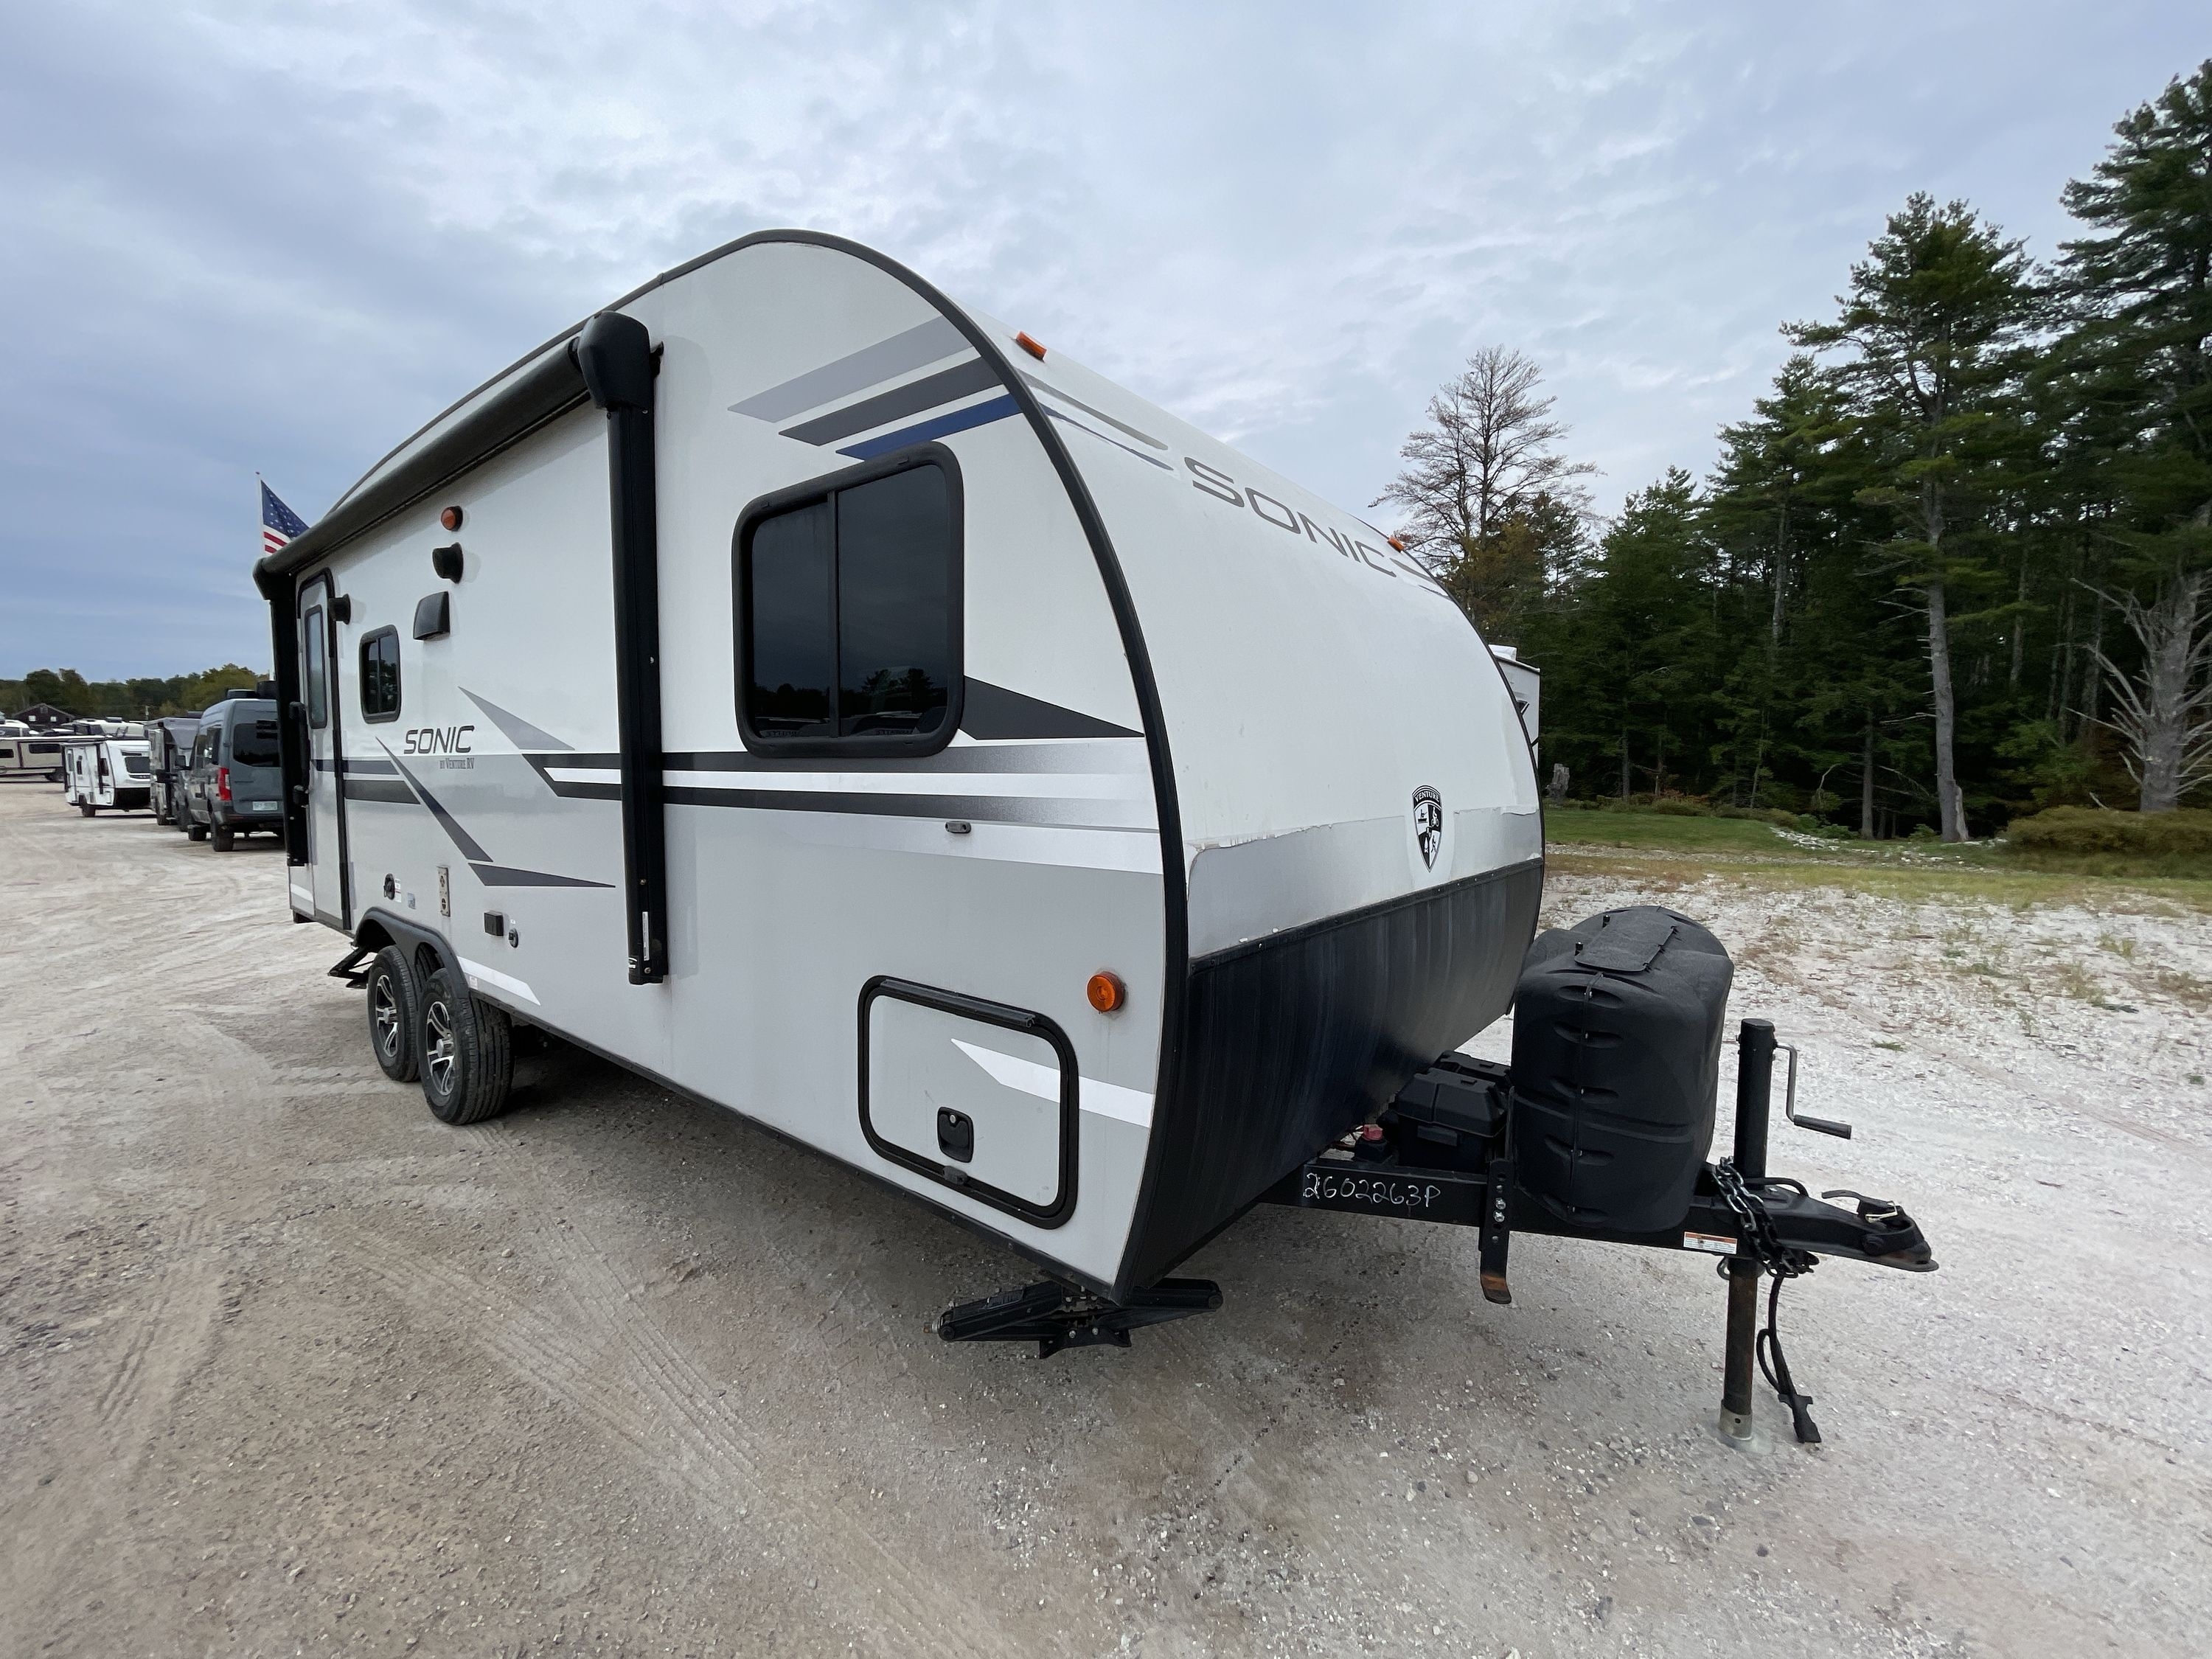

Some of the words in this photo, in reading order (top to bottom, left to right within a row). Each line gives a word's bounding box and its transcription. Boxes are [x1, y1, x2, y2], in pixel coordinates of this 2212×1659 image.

[1184, 456, 1397, 577] SONIC
[403, 725, 475, 754] SONIC
[1414, 790, 1440, 802] VENTURE
[1303, 1172, 1441, 1207] 2602263P
